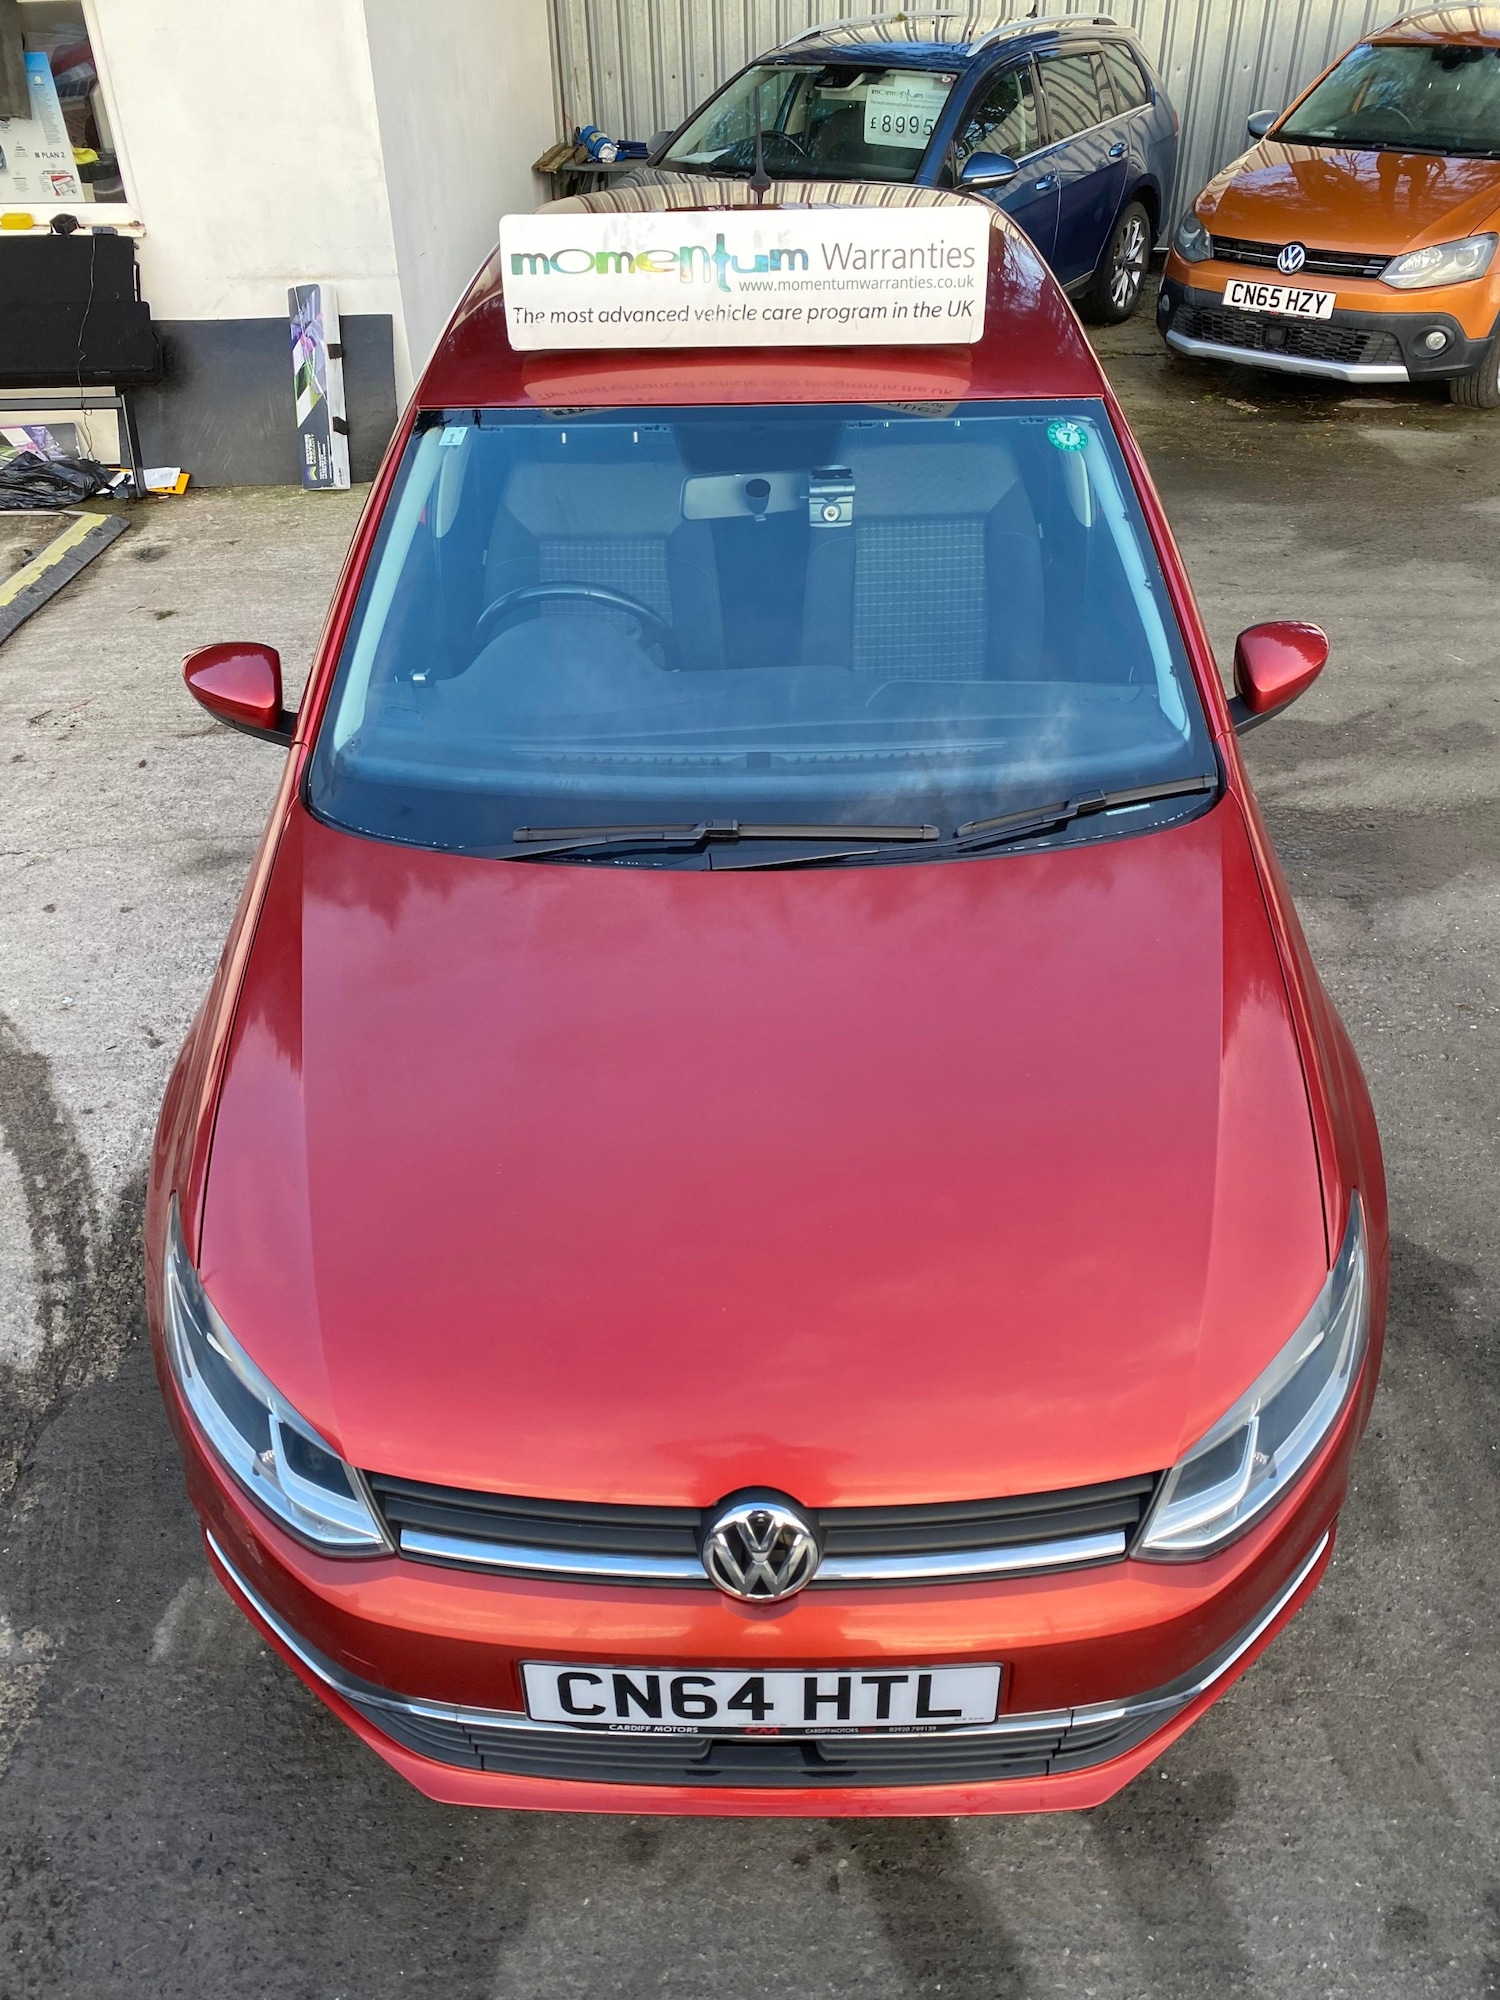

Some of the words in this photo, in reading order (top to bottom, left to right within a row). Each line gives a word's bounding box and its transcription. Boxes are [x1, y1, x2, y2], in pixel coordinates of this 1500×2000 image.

[511, 233, 809, 293] momentum
[821, 240, 976, 270] Warranties
[739, 274, 975, 291] www.momentumwarranties.co.uk
[513, 307, 545, 324] The
[550, 308, 594, 324] most
[598, 305, 689, 324] advanced
[694, 304, 758, 322] vehicle
[762, 307, 803, 321] care
[807, 305, 887, 324] program
[892, 301, 908, 319] in
[913, 301, 942, 318] the
[947, 300, 975, 318] UK
[1231, 283, 1282, 308] CN65
[1285, 290, 1327, 314] HZY
[557, 1671, 774, 1721] CN64
[804, 1674, 962, 1721] HTL
[609, 1724, 652, 1732] CARDIFF
[653, 1725, 699, 1734] MOTORS
